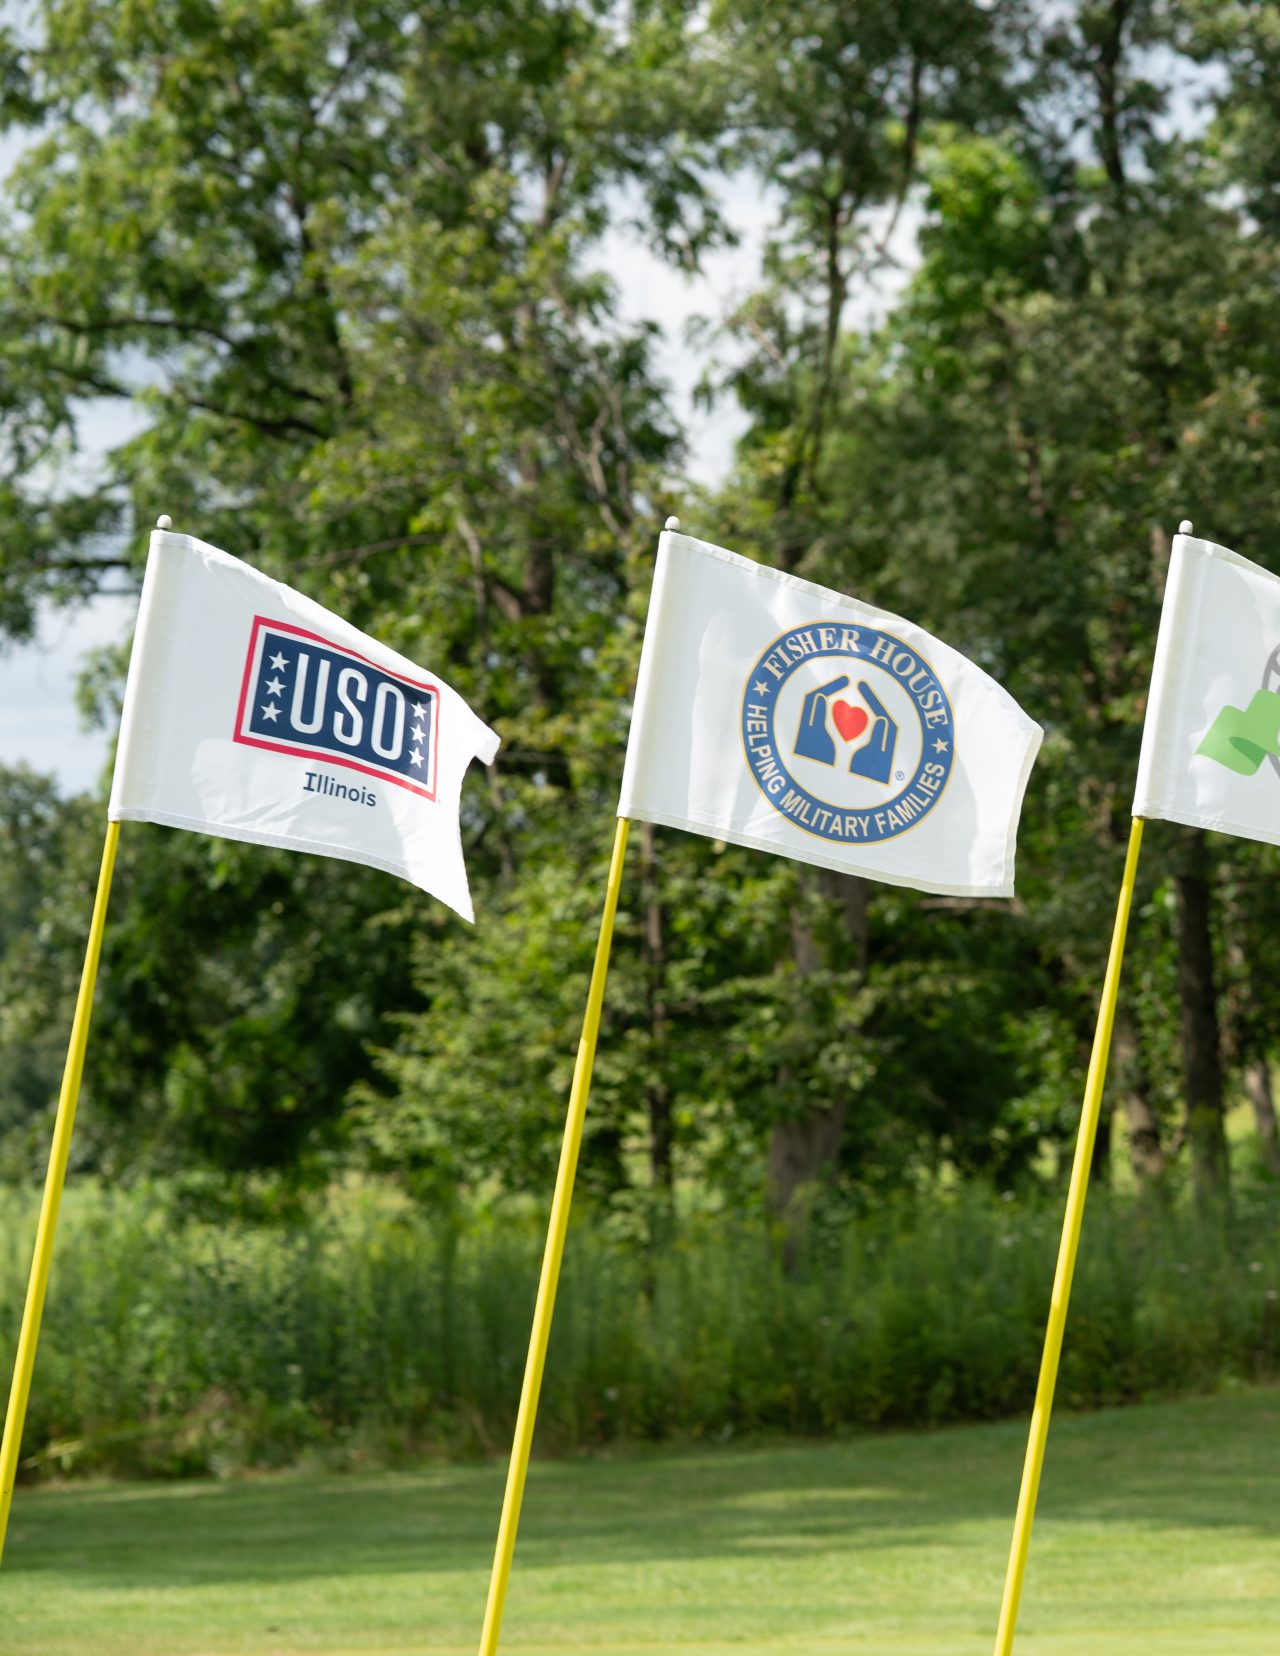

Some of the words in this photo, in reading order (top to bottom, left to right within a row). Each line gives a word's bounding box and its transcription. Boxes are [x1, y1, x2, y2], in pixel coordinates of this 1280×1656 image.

[290, 653, 405, 760] USO
[761, 627, 860, 681] FISHER
[868, 635, 949, 729] HOUSE
[303, 772, 377, 807] Illinois
[747, 703, 786, 794] HELPING
[780, 789, 870, 837] MILITARY
[875, 762, 945, 834] FAMILIES
